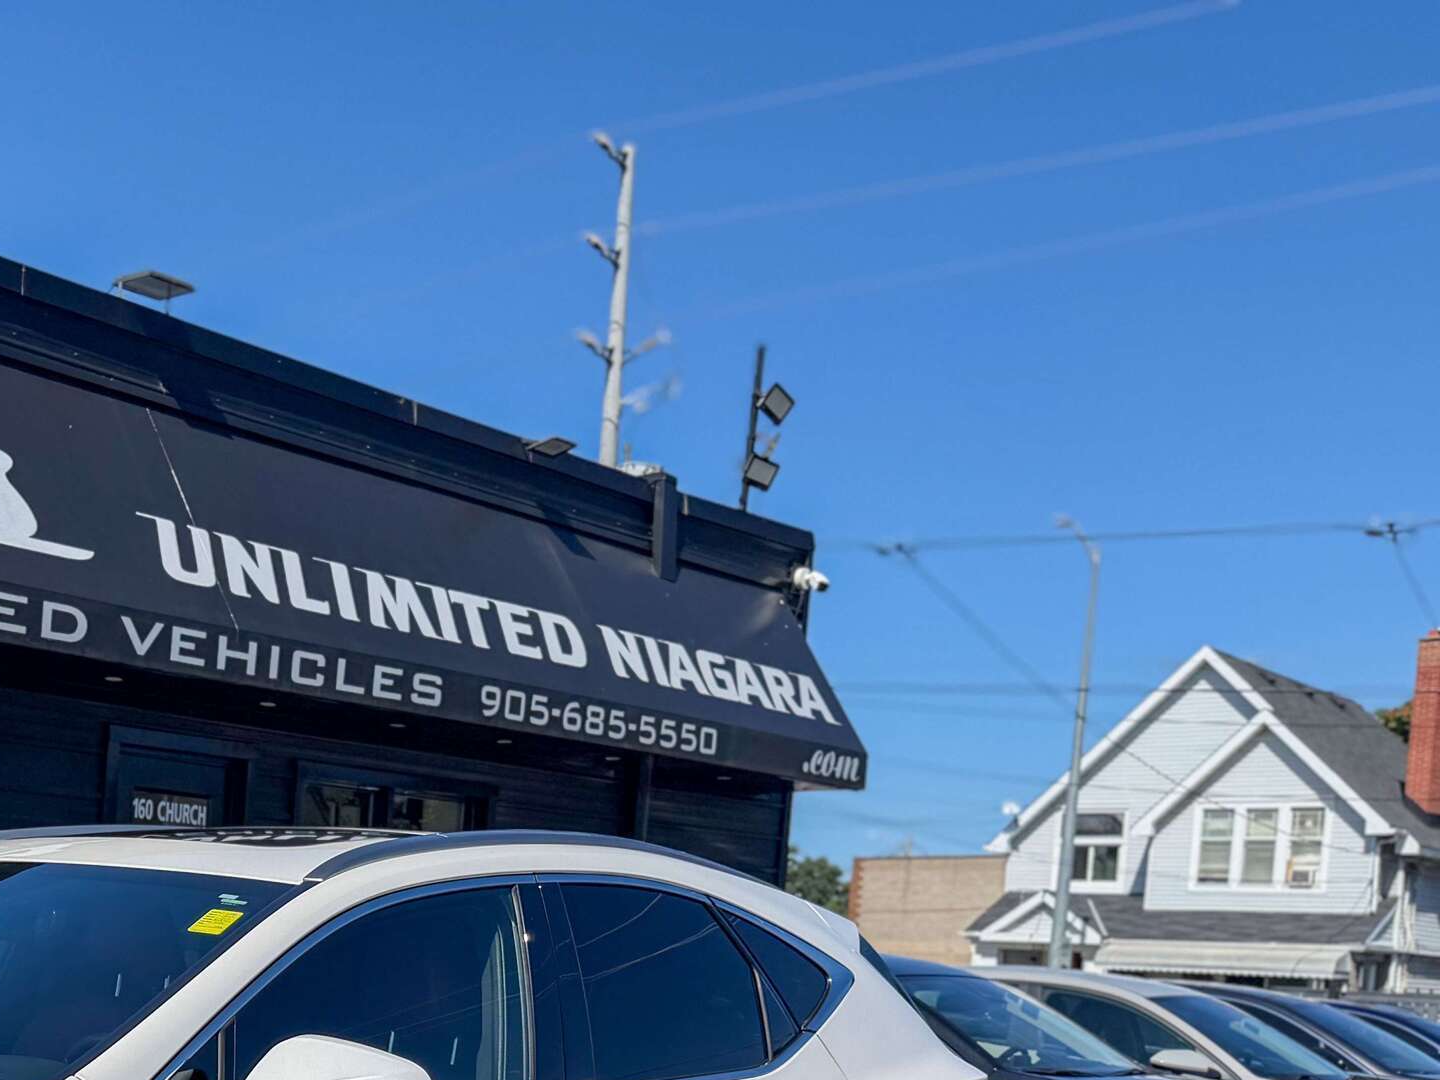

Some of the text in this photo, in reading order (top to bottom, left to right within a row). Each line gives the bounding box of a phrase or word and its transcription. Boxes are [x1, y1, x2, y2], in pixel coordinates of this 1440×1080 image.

[136, 512, 588, 668] UNLIMITED
[596, 624, 842, 726] NIAGARA
[121, 616, 443, 707] VEHICLES
[481, 685, 718, 756] 905-685-5550
[802, 750, 860, 782] .com
[132, 797, 207, 828] 160 CHURCH
